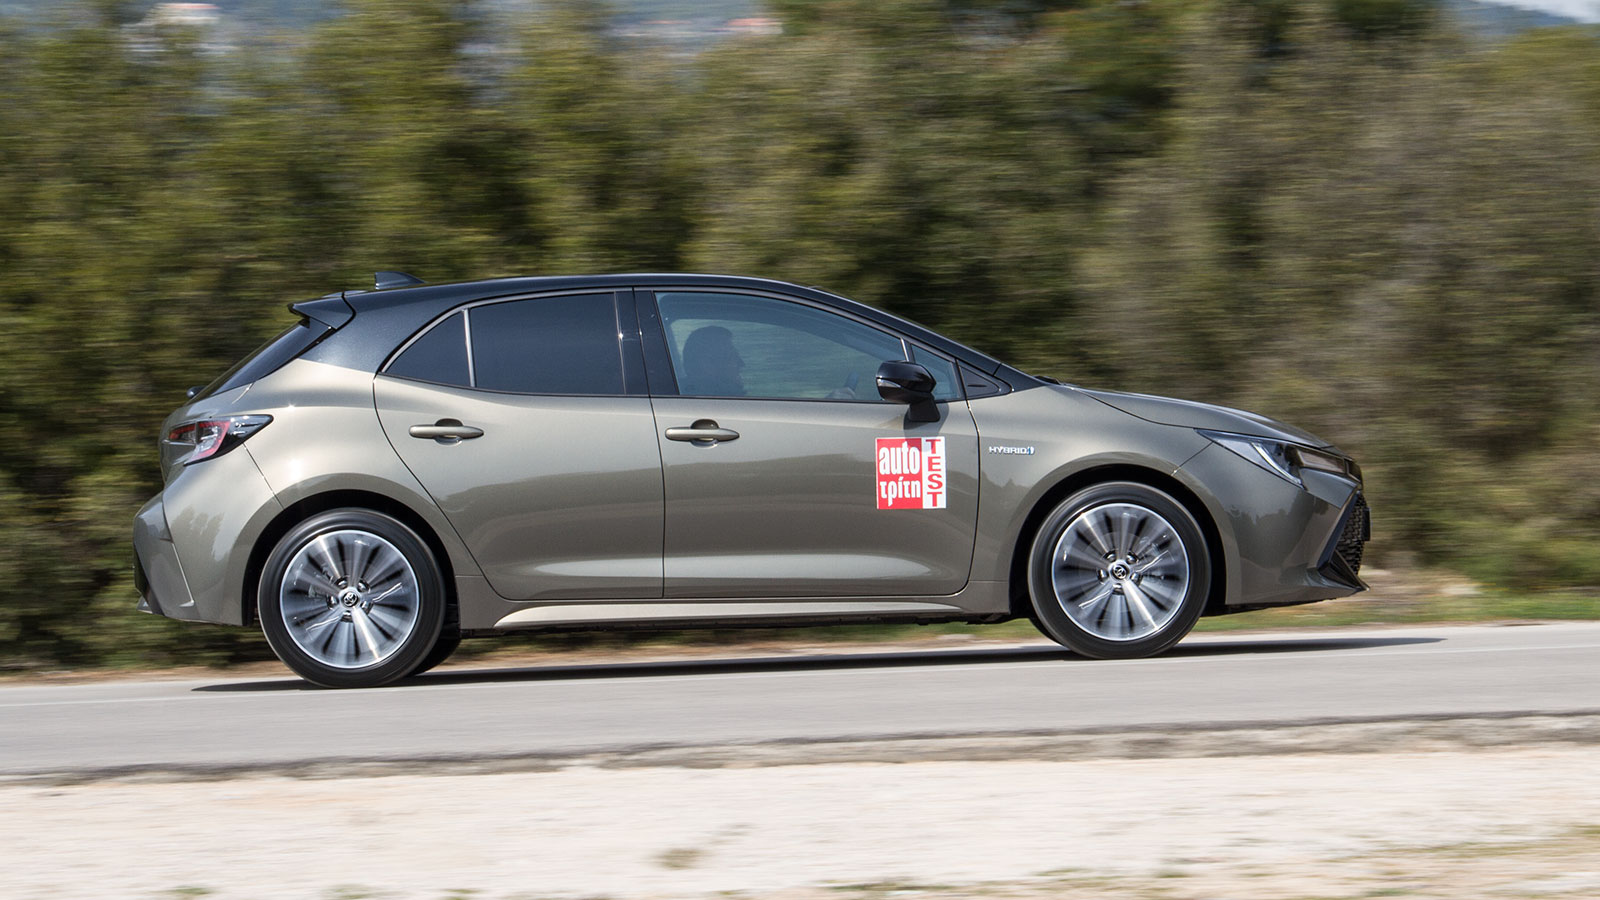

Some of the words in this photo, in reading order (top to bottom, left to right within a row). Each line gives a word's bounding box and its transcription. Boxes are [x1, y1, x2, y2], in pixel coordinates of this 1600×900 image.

[879, 441, 920, 475] auto
[988, 446, 1028, 455] HYBRID
[925, 439, 943, 507] TEST
